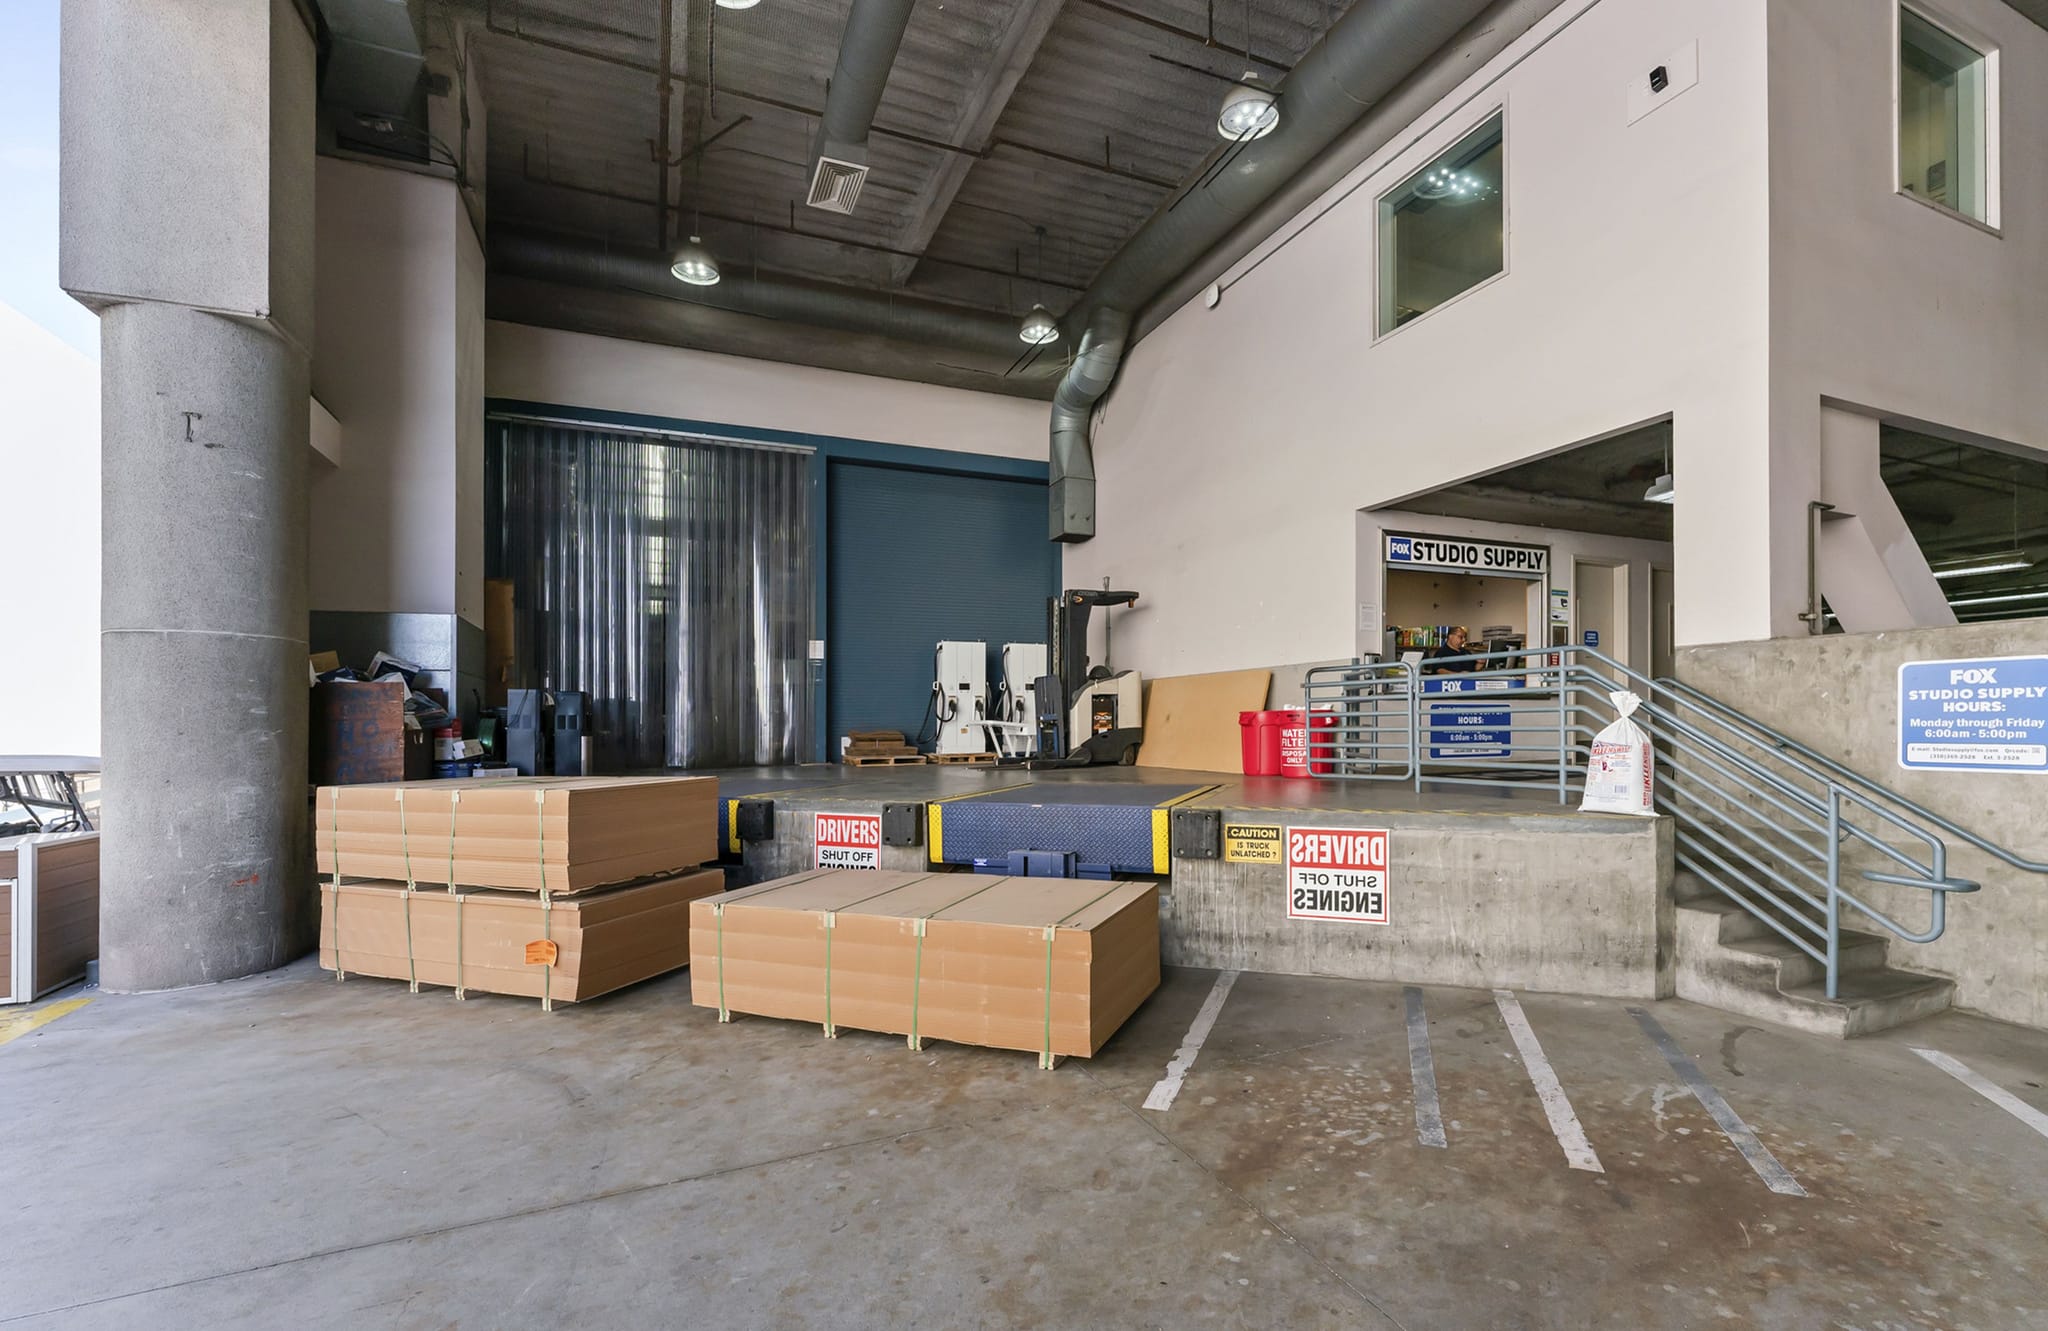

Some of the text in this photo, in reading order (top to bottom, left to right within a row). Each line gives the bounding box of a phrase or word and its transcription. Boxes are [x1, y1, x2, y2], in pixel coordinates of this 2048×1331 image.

[1391, 541, 1544, 570] FOX STUDIO SUPPLY
[1950, 668, 1997, 685] FOX
[1441, 680, 1462, 692] FOX
[1908, 686, 2047, 700] STUDIO SUPPLY
[1943, 701, 2006, 712] HOURS:
[1457, 716, 1485, 724] HOURS:
[1910, 718, 2045, 729] Monday through Friday
[1924, 729, 1970, 738] 6:00am
[1978, 729, 2027, 740] 5:00pm
[818, 818, 879, 845] DRIVERS
[1230, 828, 1277, 838] CAUTION
[822, 849, 873, 862] SHUT OFF
[1230, 850, 1271, 858] UNLATCHED
